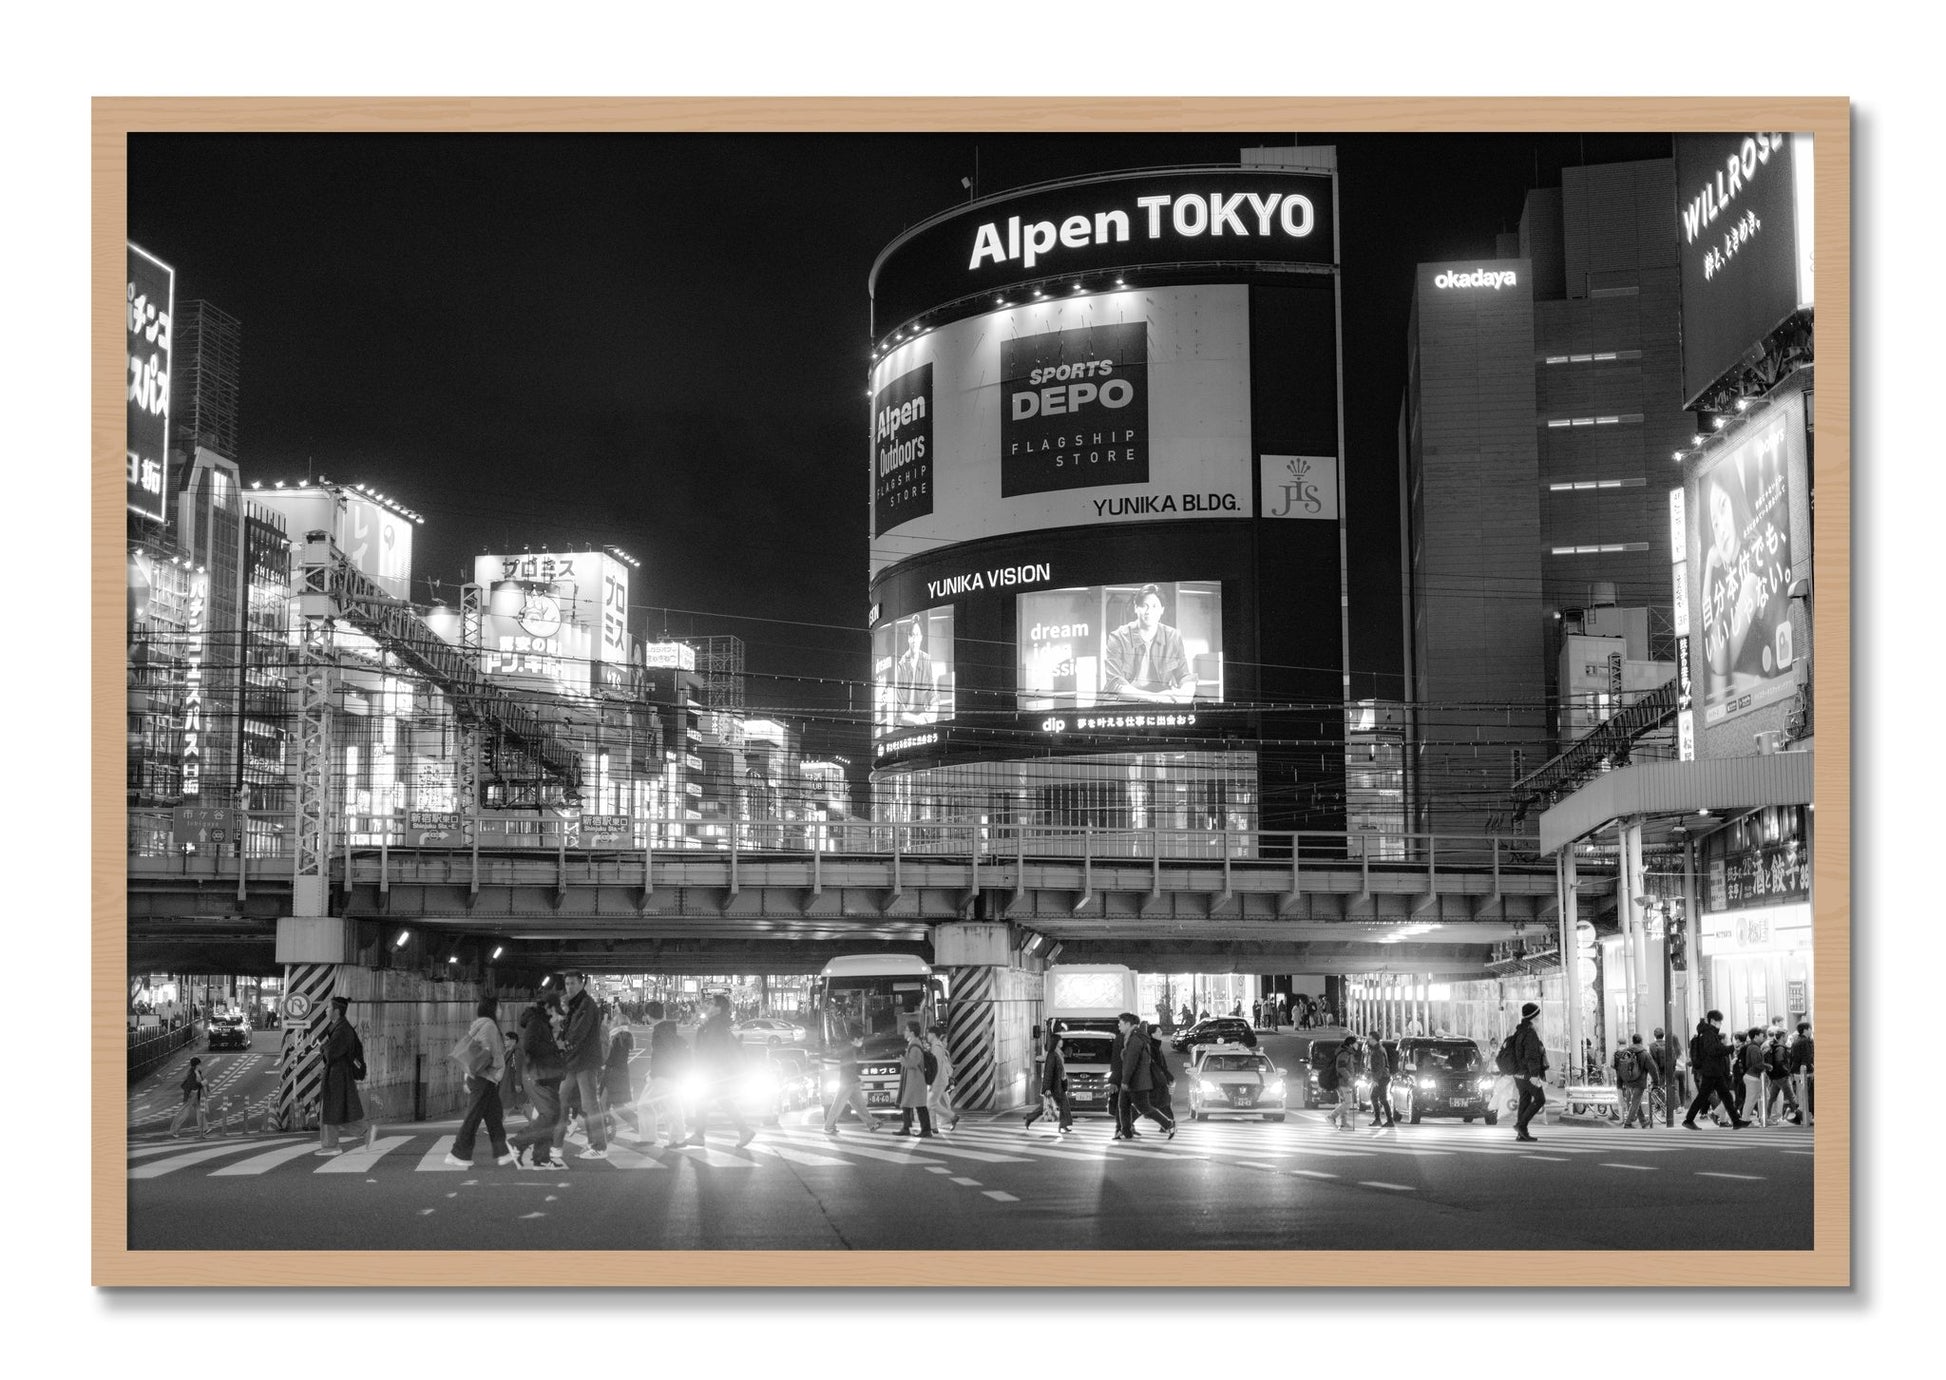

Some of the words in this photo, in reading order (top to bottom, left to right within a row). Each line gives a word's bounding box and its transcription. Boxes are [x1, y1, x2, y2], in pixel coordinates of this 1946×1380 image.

[968, 208, 1130, 271] Alpen
[1137, 192, 1315, 240] TOKYO
[1434, 268, 1517, 290] okadaya
[1029, 359, 1113, 386] SPORTS
[1011, 378, 1134, 422] DEPO
[876, 394, 926, 444] Alpen
[1012, 429, 1135, 456] FLAGSHIP
[879, 434, 926, 479] Outdoors
[1056, 449, 1135, 467] STORE
[876, 465, 927, 499] FLAGSHIP
[889, 482, 927, 508] STORE
[1093, 495, 1178, 518] YUNIKA
[1182, 492, 1242, 513] BLDG.
[254, 563, 286, 586] SHISHA
[927, 572, 985, 599] YUNIKA
[987, 562, 1051, 588] VISION
[1702, 522, 1787, 632] 自分本位でも、
[1031, 622, 1089, 641] dream
[1042, 717, 1066, 733] dip
